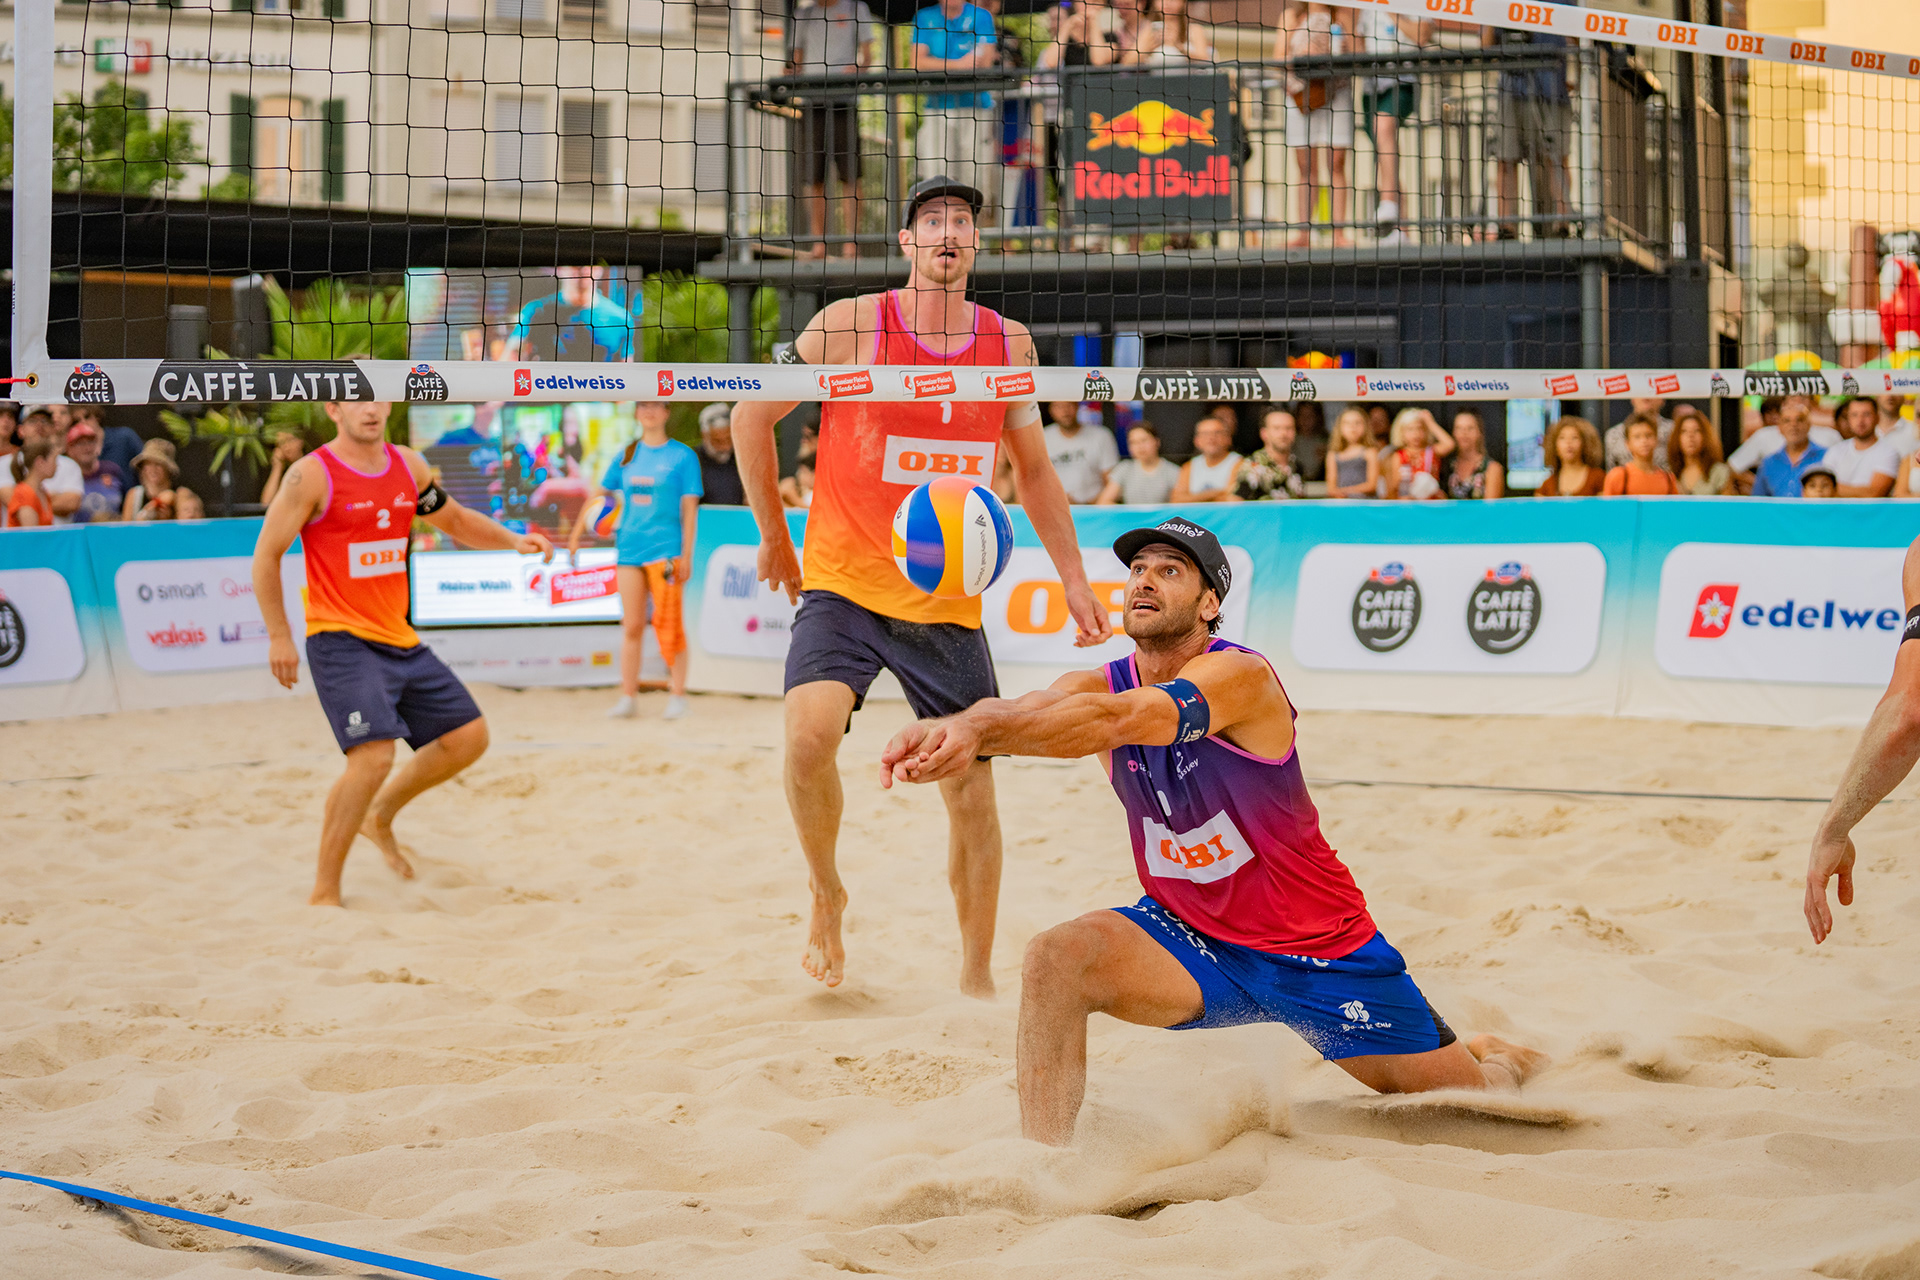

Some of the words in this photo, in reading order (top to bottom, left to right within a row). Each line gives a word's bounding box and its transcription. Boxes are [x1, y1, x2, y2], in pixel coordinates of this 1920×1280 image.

[1426, 0, 1474, 16] OBI
[1508, 3, 1554, 26] OBI
[1585, 13, 1628, 36] OBI
[1657, 23, 1698, 45] OBI
[1725, 33, 1764, 54] OBI
[1790, 42, 1827, 63] OBI
[1850, 50, 1886, 71] OBI
[1074, 159, 1150, 200] Red
[1155, 155, 1231, 198] Bull
[69, 374, 109, 391] CAFFÈ
[158, 362, 258, 402] CAFFÈ
[270, 371, 361, 402] LATTE
[408, 373, 443, 389] CAFFÈ
[534, 375, 626, 390] edelweiss
[677, 376, 762, 391] edelweiss
[1085, 378, 1111, 391] CAFFÈ
[1140, 370, 1200, 400] CAFFÈ
[1205, 378, 1263, 400] LATTE
[1291, 379, 1314, 391] CAFFÈ
[1369, 379, 1426, 392] edelweiss
[1457, 379, 1510, 392] edelweiss
[1745, 371, 1786, 396] CAFFÈ
[1788, 376, 1827, 395] LATTE
[70, 391, 110, 403] LATTE
[410, 389, 443, 401] LATTE
[1087, 391, 1111, 400] LATTE
[1293, 391, 1314, 400] LATTE
[940, 401, 952, 425] 1
[898, 451, 984, 476] OBI
[376, 508, 391, 529] 2
[157, 582, 207, 599] smart
[1358, 584, 1416, 610] CAFFÈ
[1474, 584, 1535, 611] CAFFÈ
[1357, 609, 1413, 630] LATTE
[1473, 610, 1533, 631] LATTE
[1741, 599, 1901, 631] edelwe
[147, 620, 207, 645] valais
[1160, 834, 1234, 869] OBI
